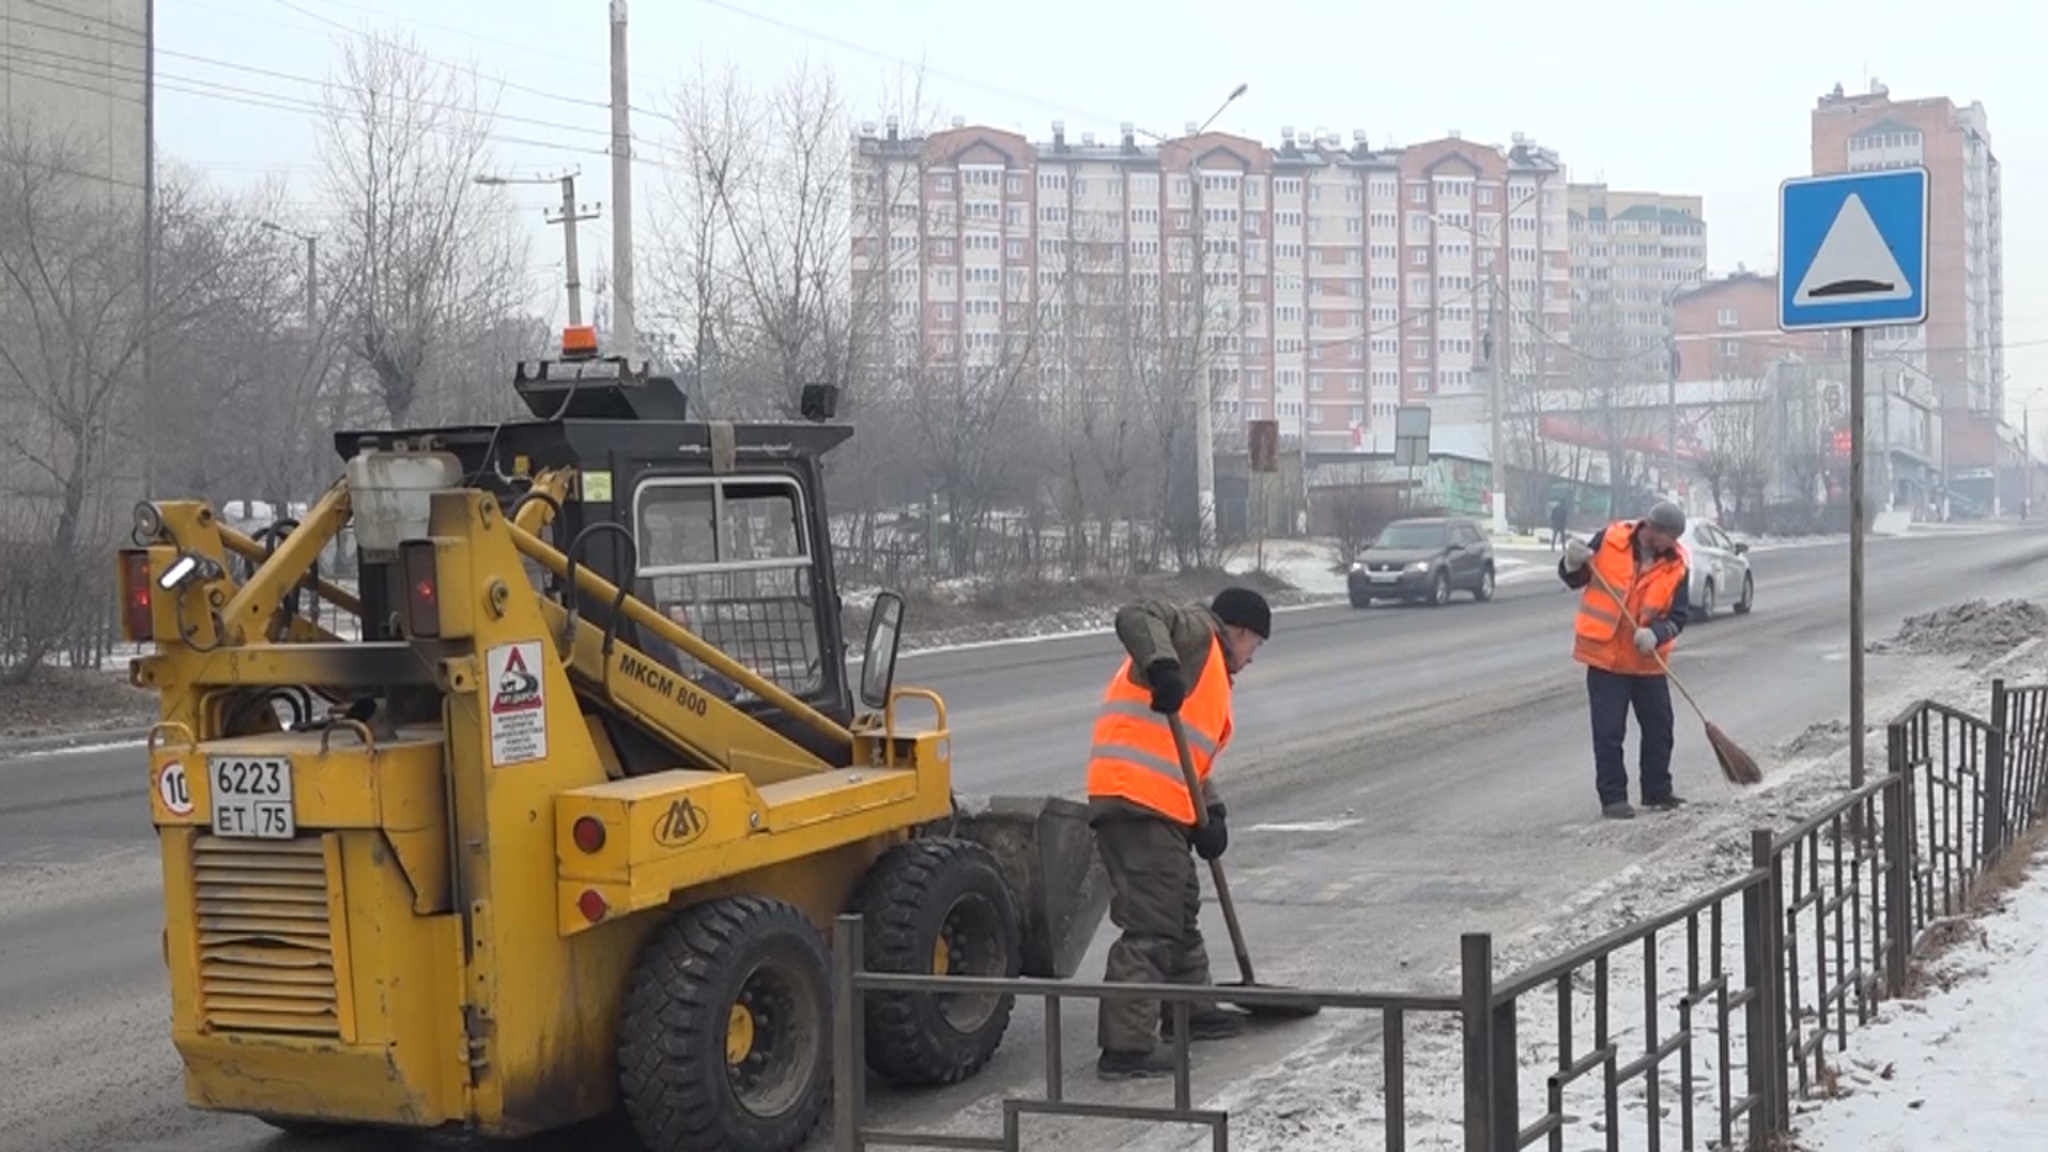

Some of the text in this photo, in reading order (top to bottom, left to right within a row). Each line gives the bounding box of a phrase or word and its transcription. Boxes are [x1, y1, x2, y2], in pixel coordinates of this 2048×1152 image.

[619, 654, 708, 717] МКСМ 800
[218, 762, 281, 795] 6223
[261, 807, 287, 834] 75
